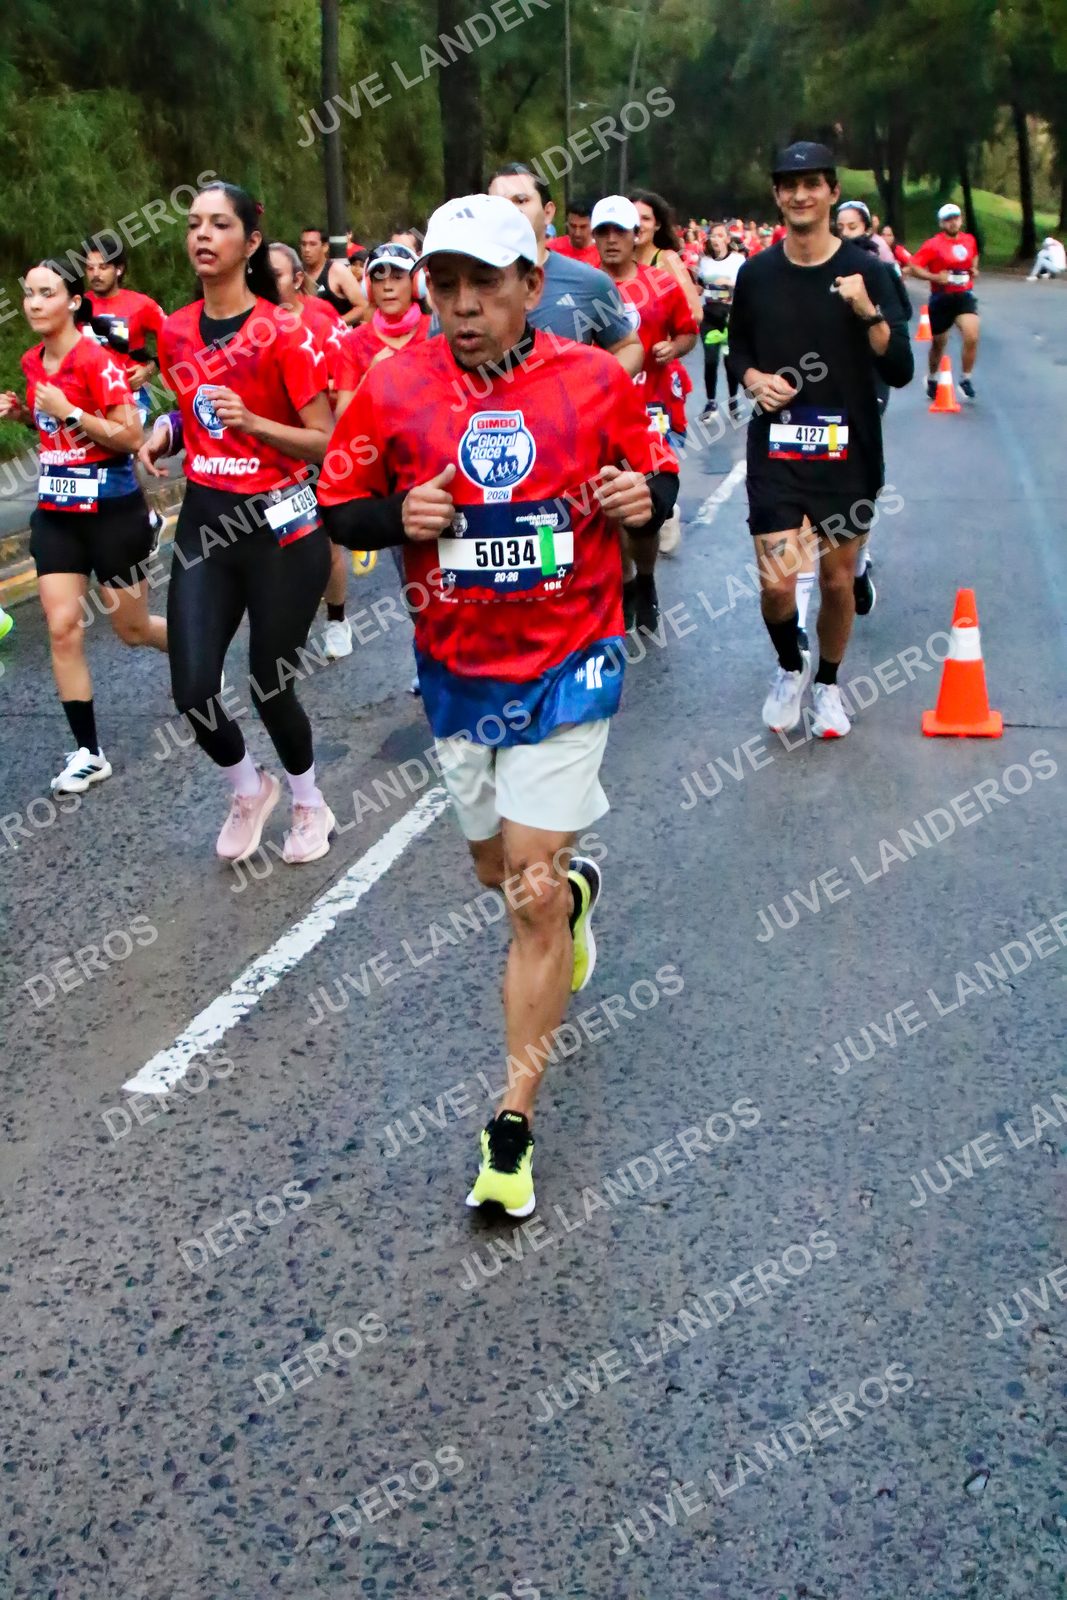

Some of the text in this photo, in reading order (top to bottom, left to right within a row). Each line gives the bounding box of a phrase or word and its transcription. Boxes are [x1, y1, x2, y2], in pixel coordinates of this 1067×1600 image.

[477, 419, 517, 429] BIMBO
[478, 433, 516, 447] Global
[796, 427, 824, 442] 4127
[470, 446, 502, 459] Race
[50, 479, 76, 494] 4028
[475, 539, 536, 567] 5034
[543, 580, 562, 591] 10K
